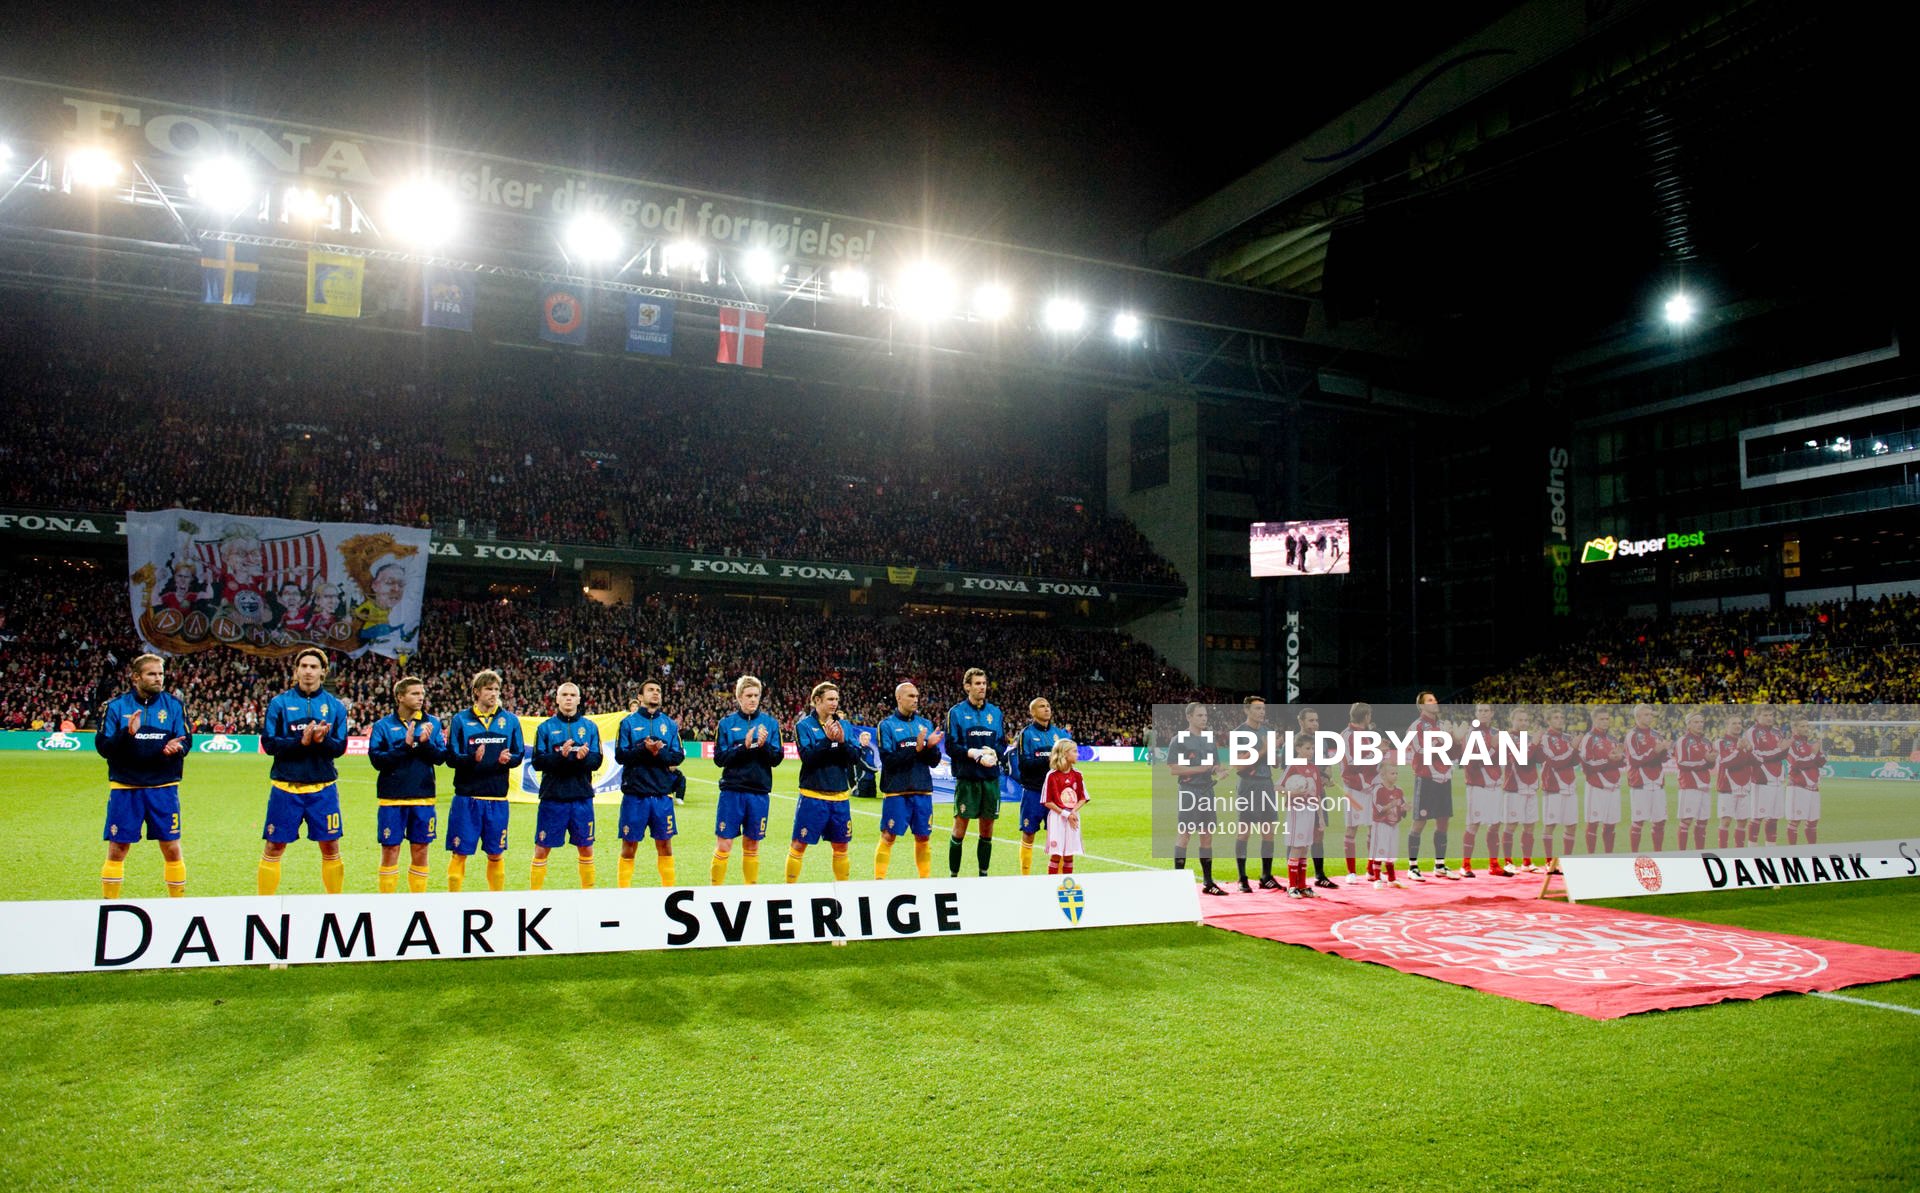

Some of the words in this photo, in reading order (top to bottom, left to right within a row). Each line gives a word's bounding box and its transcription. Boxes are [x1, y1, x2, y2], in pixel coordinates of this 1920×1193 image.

[63, 96, 378, 183] FONA
[619, 197, 686, 232] god
[696, 201, 876, 263] fornøjelse!
[433, 300, 461, 314] FIFA
[0, 514, 101, 534] FONA
[474, 544, 562, 563] FONA
[690, 558, 769, 576] FONA
[780, 564, 855, 582] FONA
[963, 577, 1030, 593] FONA
[1038, 582, 1102, 597] FONA
[1286, 611, 1300, 704] FONA
[44, 740, 73, 749] Arla
[207, 742, 234, 751] Arla
[170, 813, 179, 830] 3
[326, 813, 340, 830] 10
[428, 817, 436, 832] 8
[667, 815, 674, 829] 5
[760, 817, 767, 831] 6
[500, 829, 508, 844] 2
[1701, 852, 1870, 889] DANMARK
[1899, 842, 1920, 875] S
[94, 903, 554, 967] DANMARK
[664, 889, 962, 946] SVERIGE
